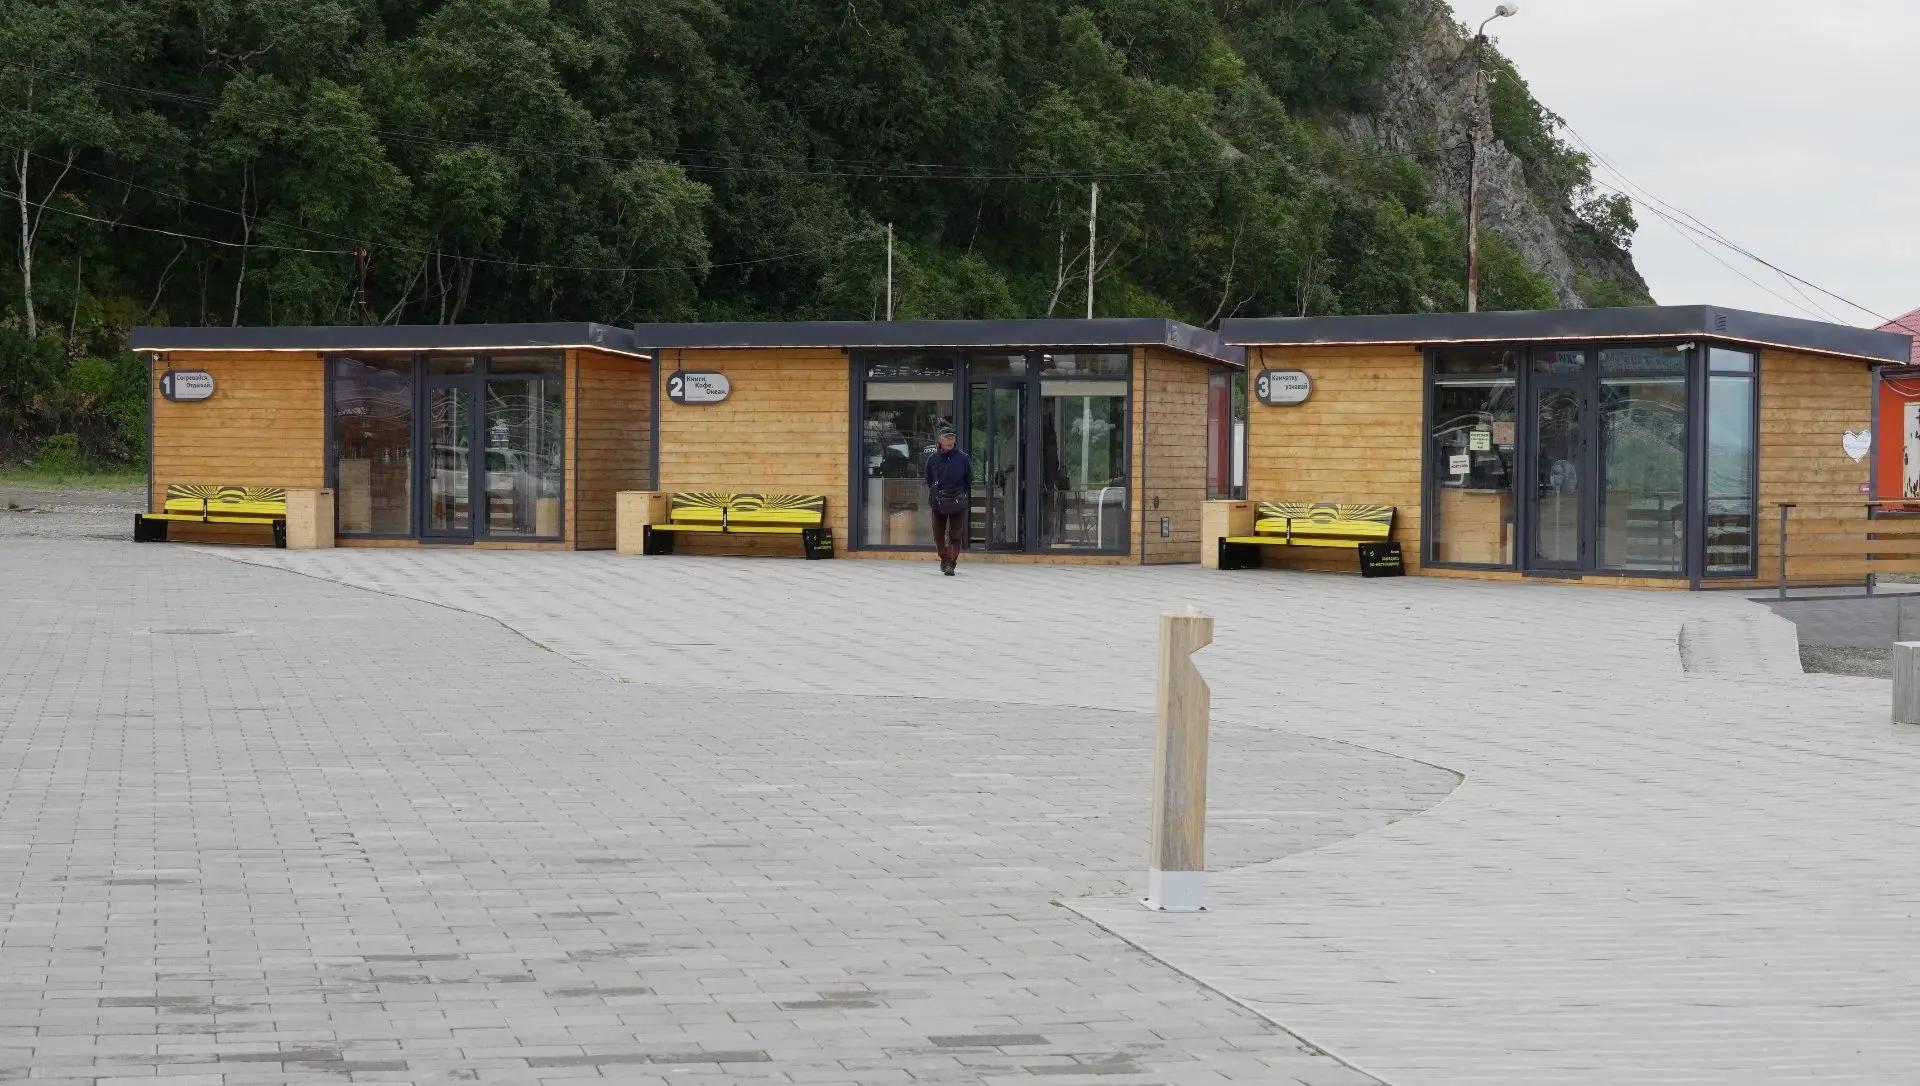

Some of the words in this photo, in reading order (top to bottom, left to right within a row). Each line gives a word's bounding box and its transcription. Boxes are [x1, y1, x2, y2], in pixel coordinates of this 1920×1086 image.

[163, 376, 170, 394] 1
[670, 377, 682, 396] 2
[1258, 376, 1269, 398] 3
